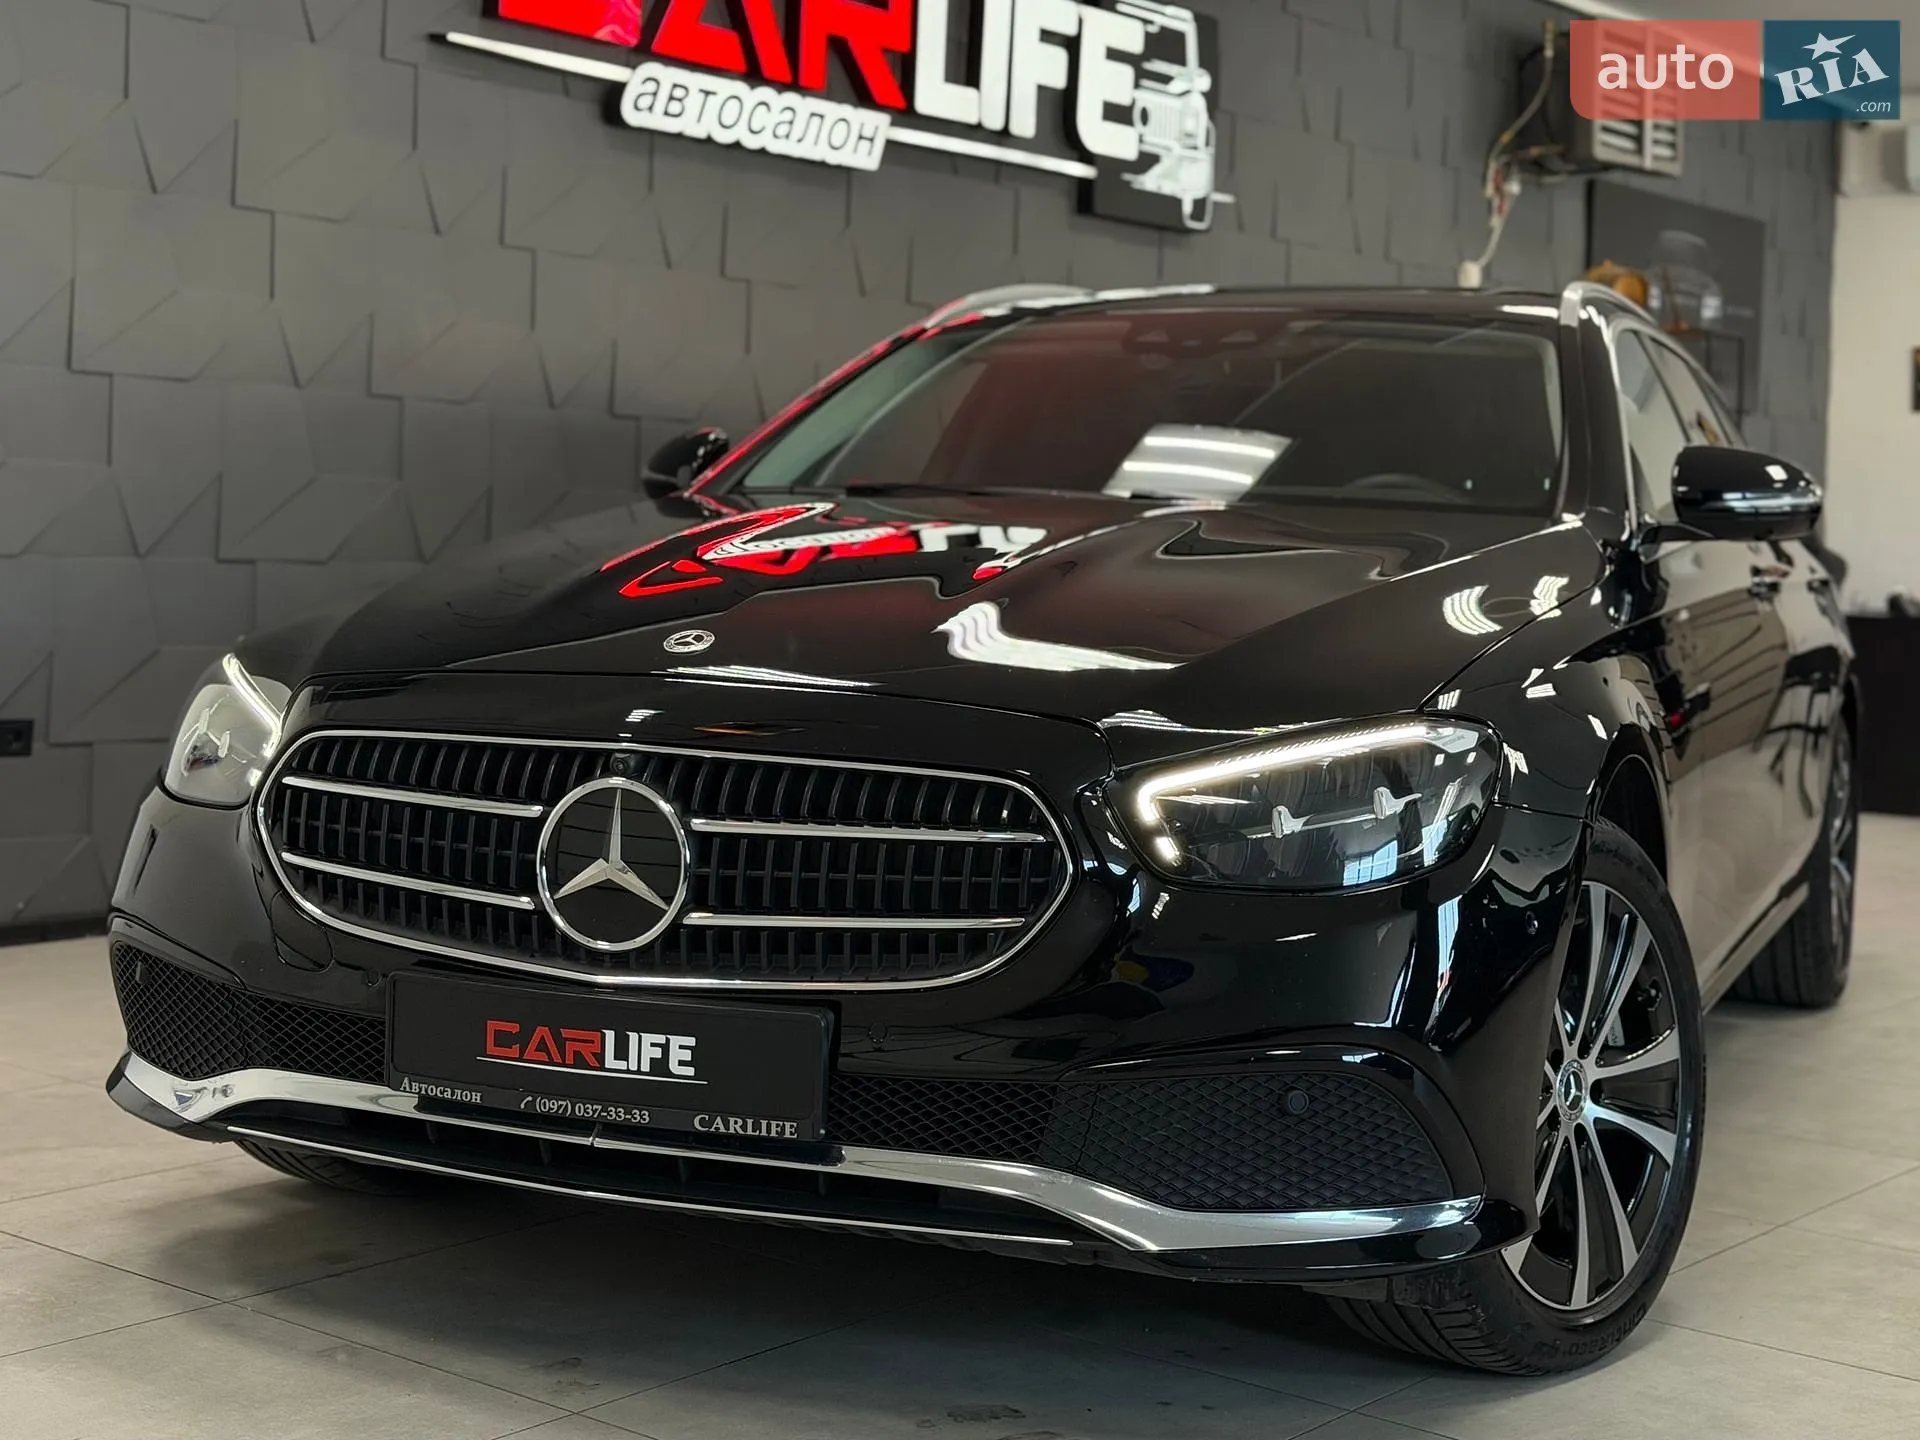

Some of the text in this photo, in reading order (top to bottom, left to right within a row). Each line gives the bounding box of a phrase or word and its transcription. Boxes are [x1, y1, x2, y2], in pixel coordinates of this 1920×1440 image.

[633, 76, 879, 158] автосалон
[486, 1019, 696, 1076] CARLIFE
[400, 1076, 482, 1104] Автосалон
[535, 1096, 650, 1124] (097) 037-33-33
[693, 1114, 799, 1140] CARLIFE
